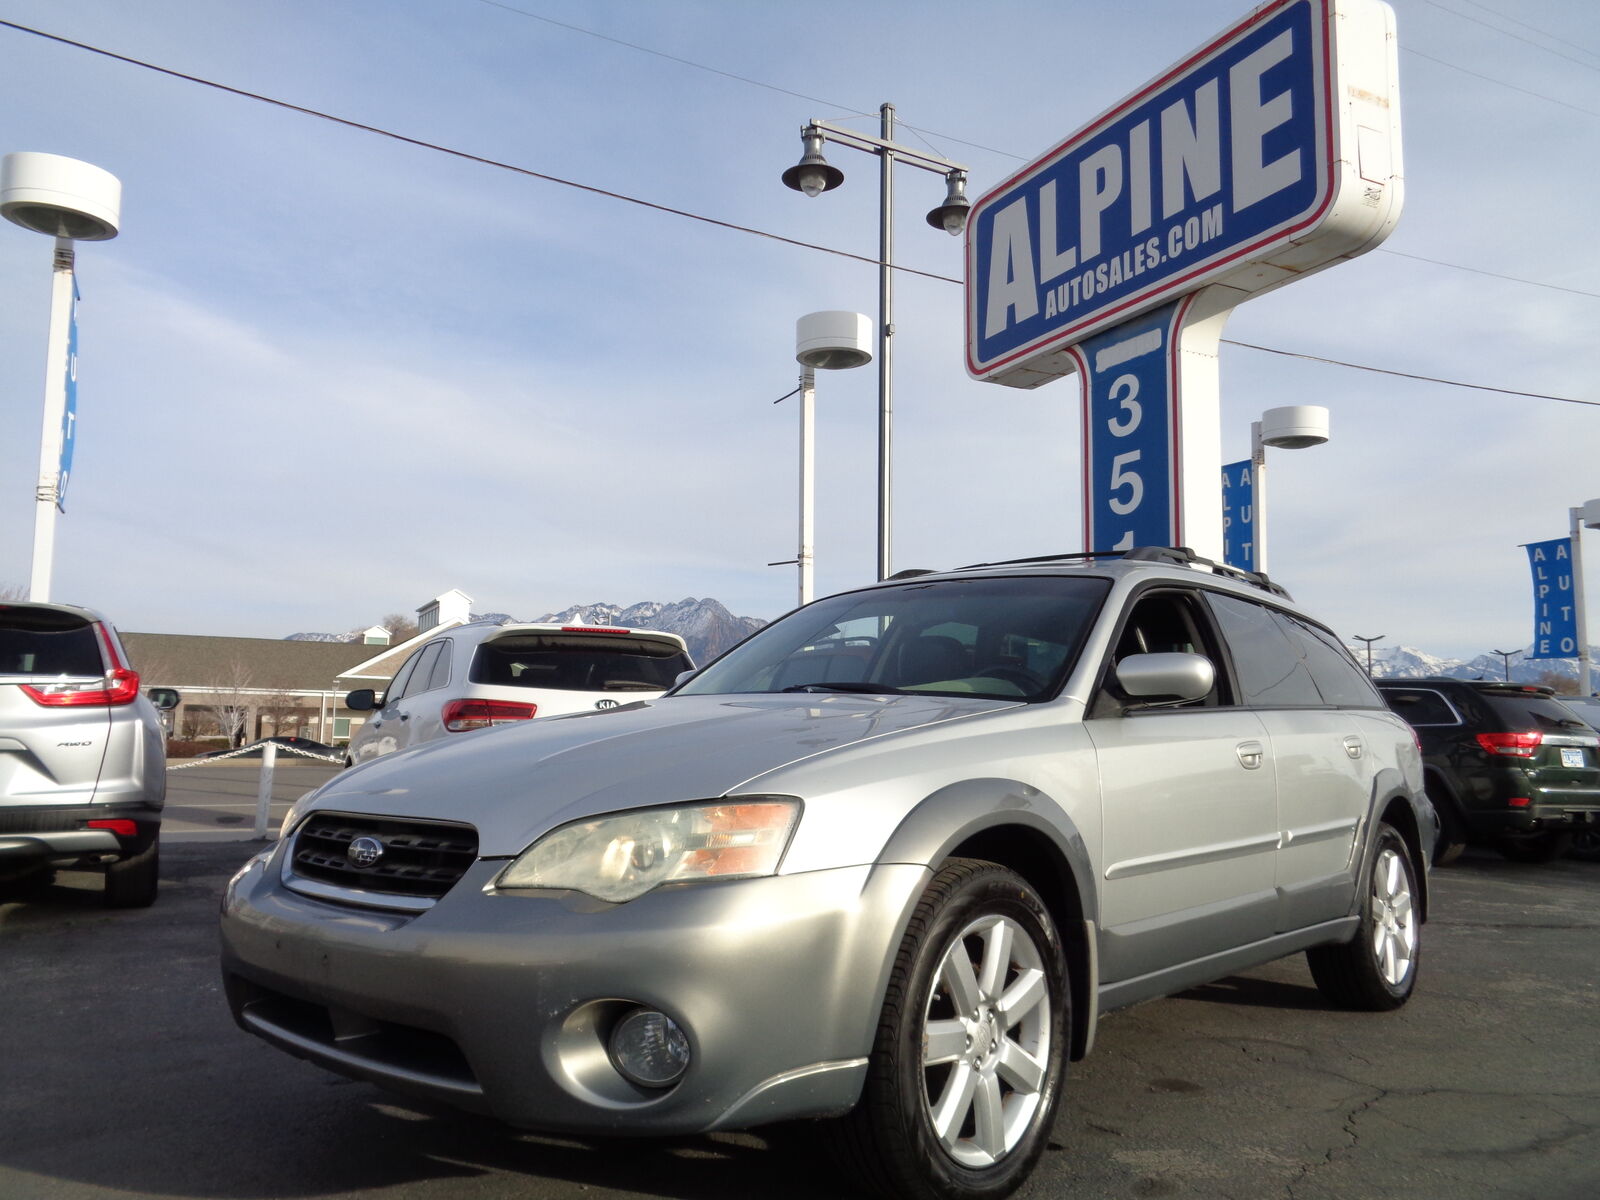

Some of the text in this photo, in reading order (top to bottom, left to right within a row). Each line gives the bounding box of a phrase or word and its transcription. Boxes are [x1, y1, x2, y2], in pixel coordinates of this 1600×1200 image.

[985, 28, 1302, 340] ALPINE
[1045, 203, 1223, 320] AUTOSALES.COM
[1534, 548, 1551, 654] ALPINE
[1556, 544, 1574, 653] AUTO
